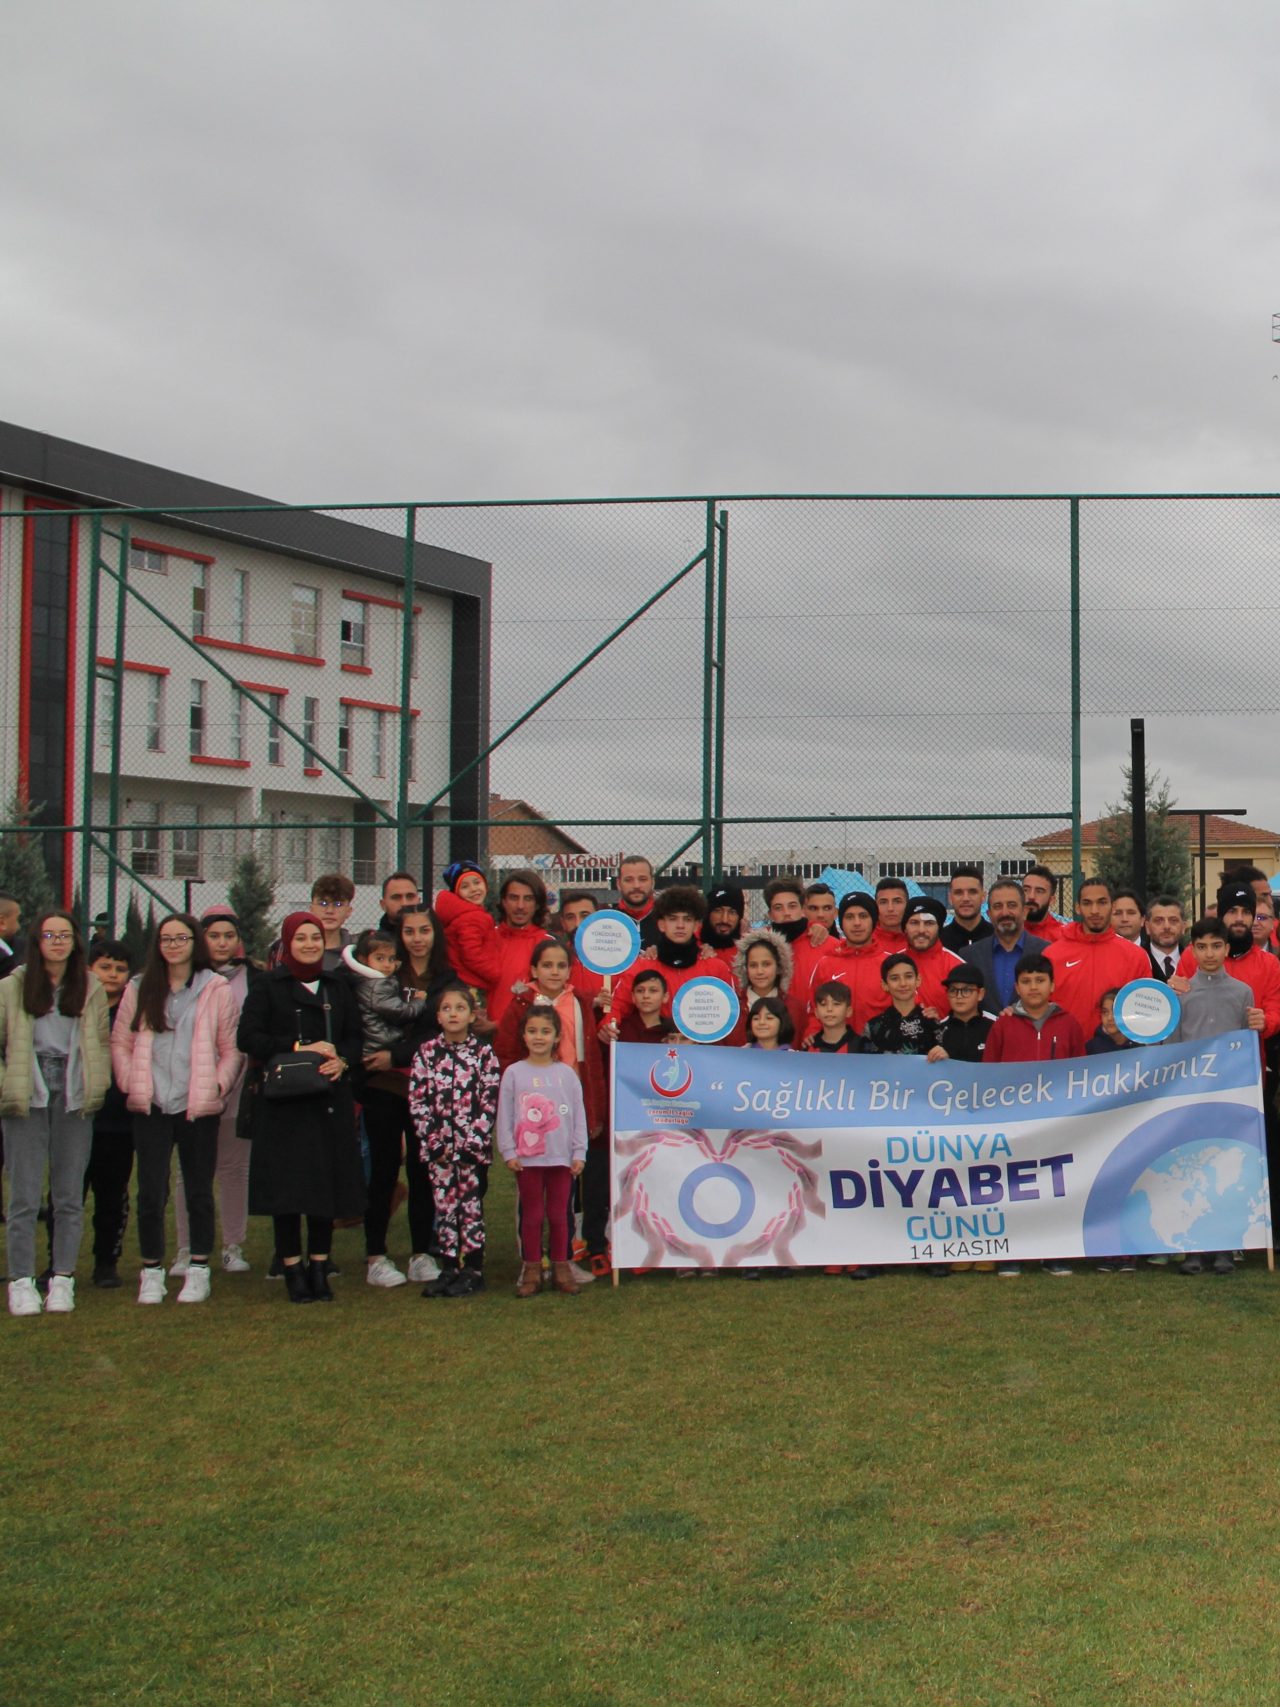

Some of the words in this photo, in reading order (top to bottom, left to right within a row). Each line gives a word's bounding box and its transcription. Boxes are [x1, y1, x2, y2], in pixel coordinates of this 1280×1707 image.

[733, 1079, 856, 1119] Sağlıklı
[869, 1080, 915, 1111] Bir
[927, 1072, 1053, 1117] Gelecek
[1067, 1053, 1218, 1099] Hakkımız
[886, 1130, 1012, 1164] DÜNYA
[829, 1153, 1074, 1209] DİYABET
[906, 1207, 1006, 1241] GÜNÜ
[910, 1243, 934, 1260] 14
[943, 1238, 1010, 1257] KASIM
